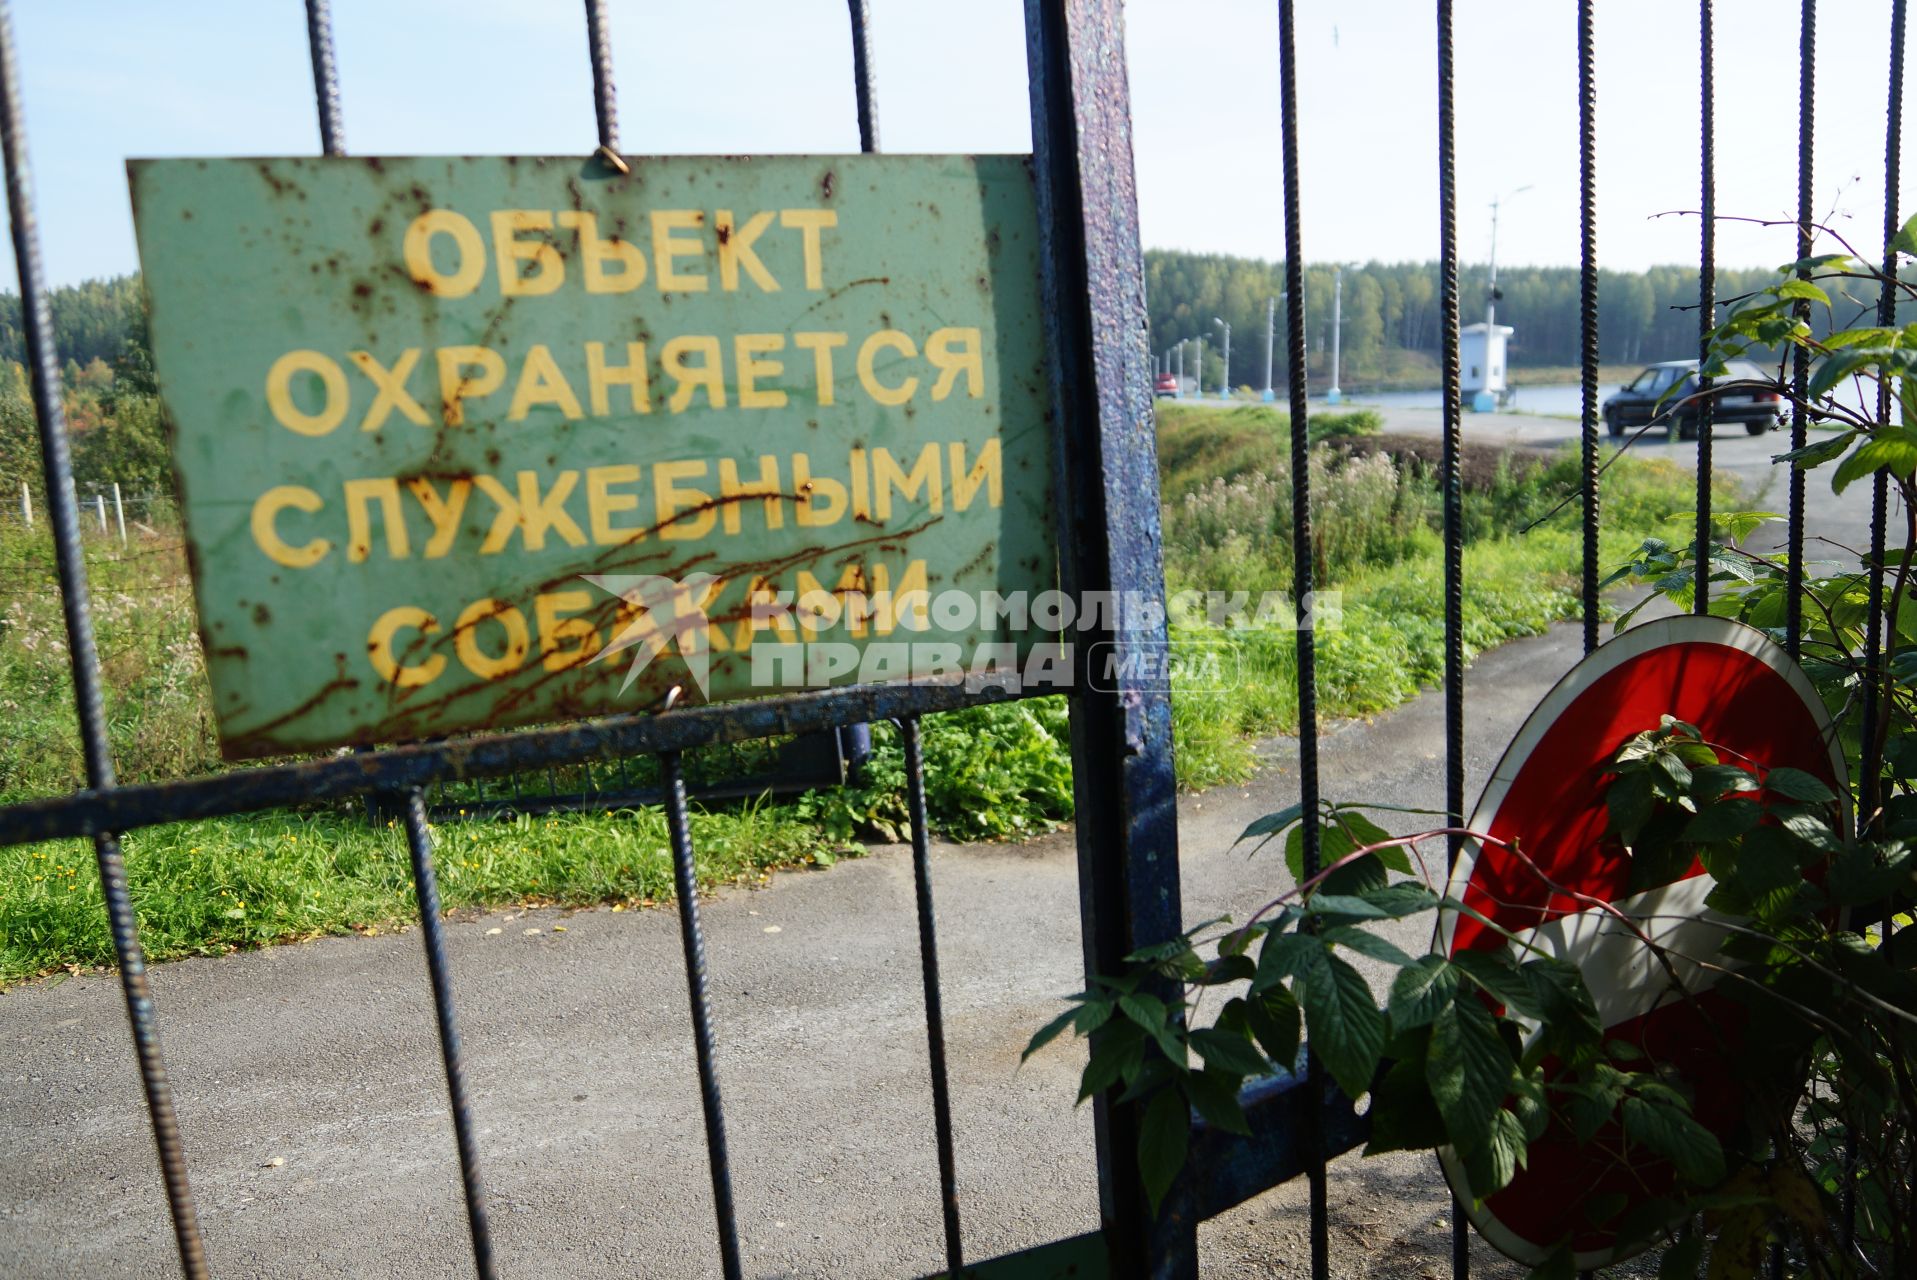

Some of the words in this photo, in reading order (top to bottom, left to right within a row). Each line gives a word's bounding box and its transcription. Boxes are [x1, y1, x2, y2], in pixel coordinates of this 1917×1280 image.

[403, 208, 837, 297] ОБЪЕКТ
[266, 327, 985, 436] ОХРАНЯЕТСЯ
[250, 438, 1002, 567] СЛУЖЕБНЫМИ
[369, 559, 930, 687] СОБАКАМИ
